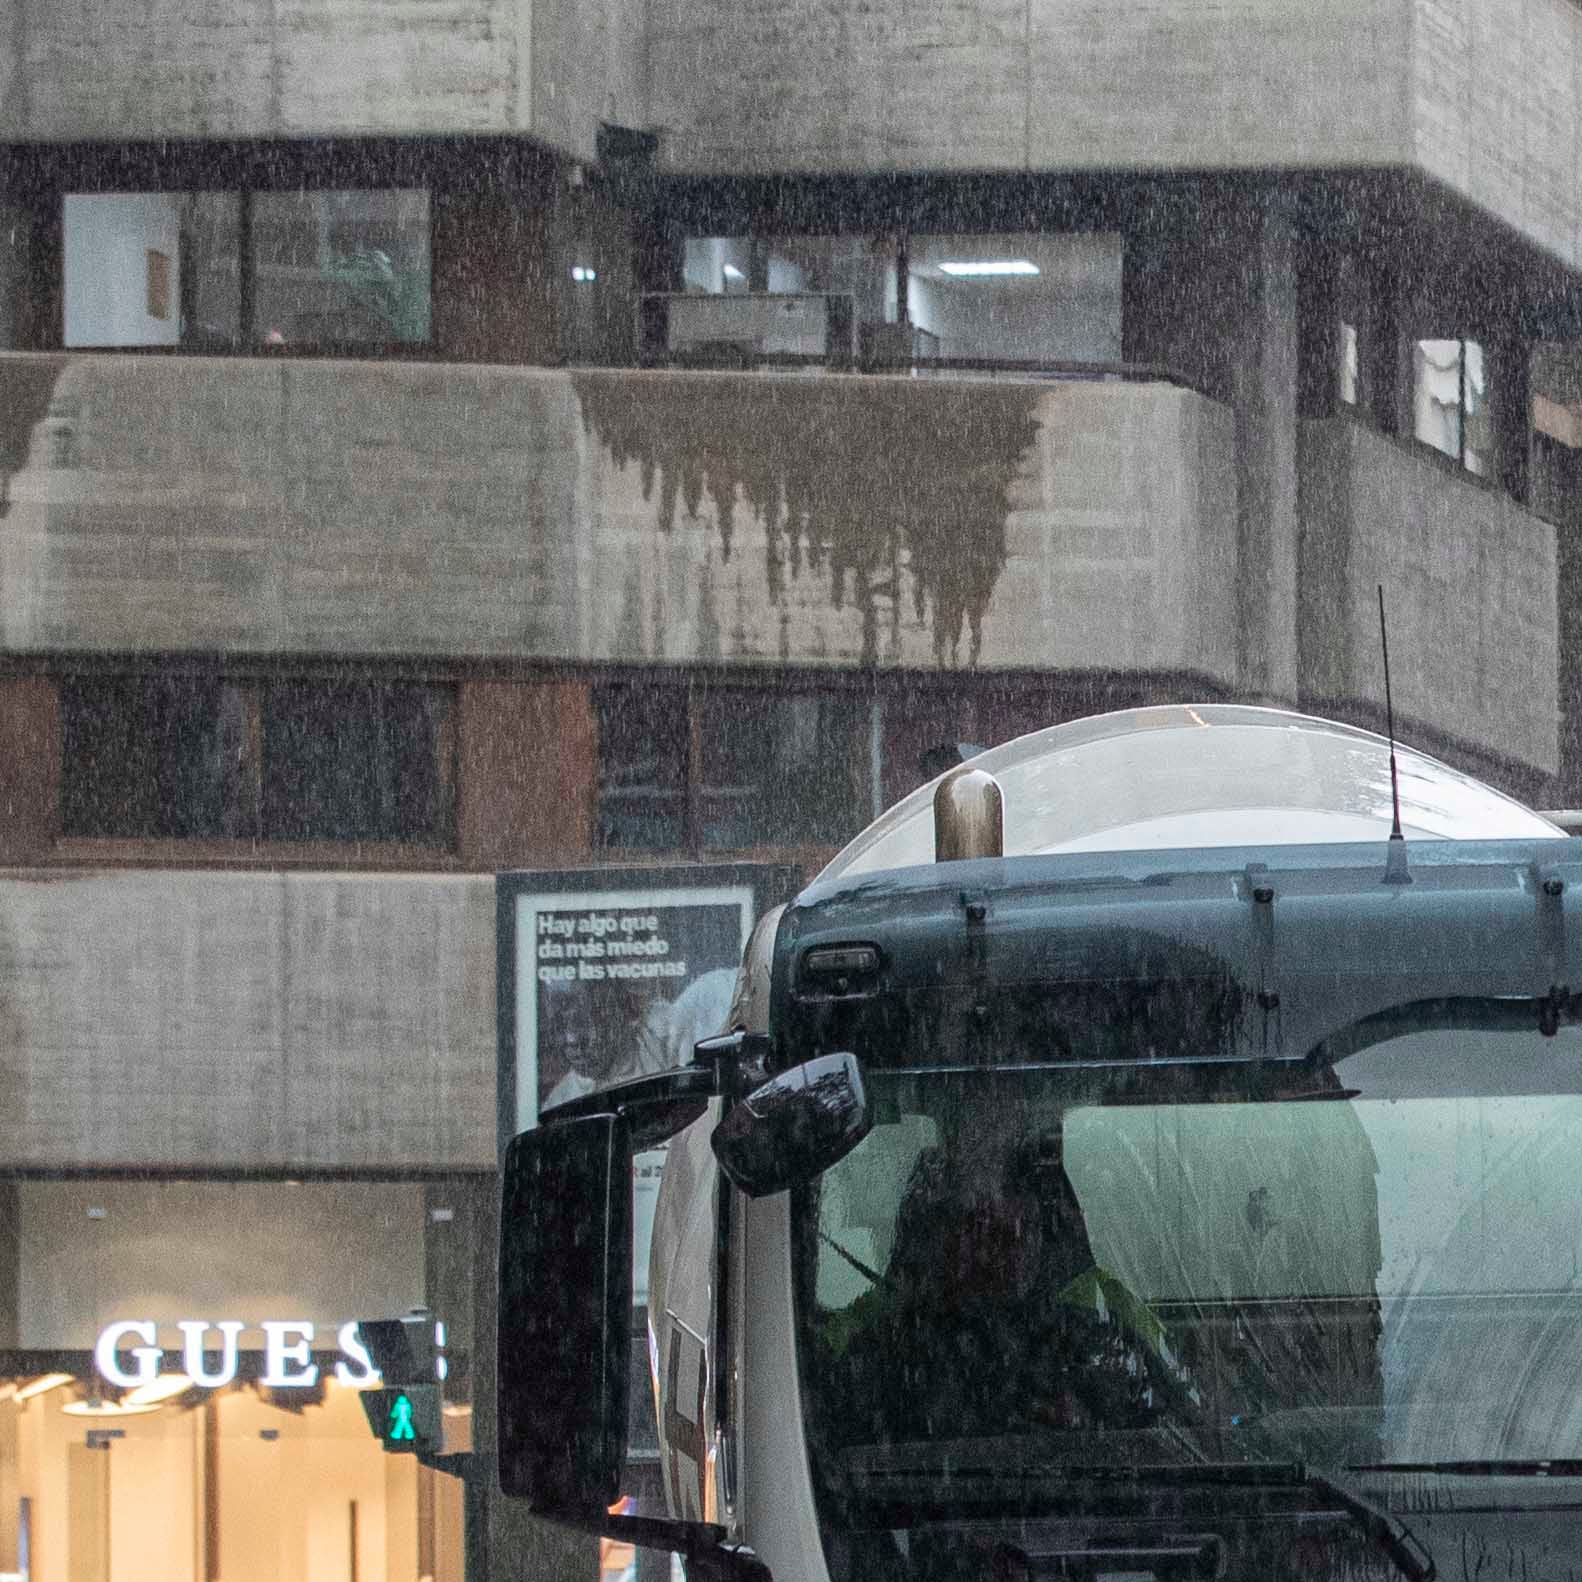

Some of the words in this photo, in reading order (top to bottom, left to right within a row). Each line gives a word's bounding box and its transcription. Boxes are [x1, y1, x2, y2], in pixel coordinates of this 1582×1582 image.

[538, 914, 576, 938] Hay
[577, 912, 618, 936] algo
[620, 914, 659, 935] que
[538, 939, 564, 959] da
[566, 937, 604, 958] más
[607, 935, 669, 956] miedo
[538, 964, 576, 984] que
[579, 960, 605, 980] las
[606, 960, 687, 979] vacunas
[94, 1319, 448, 1388] GUES
